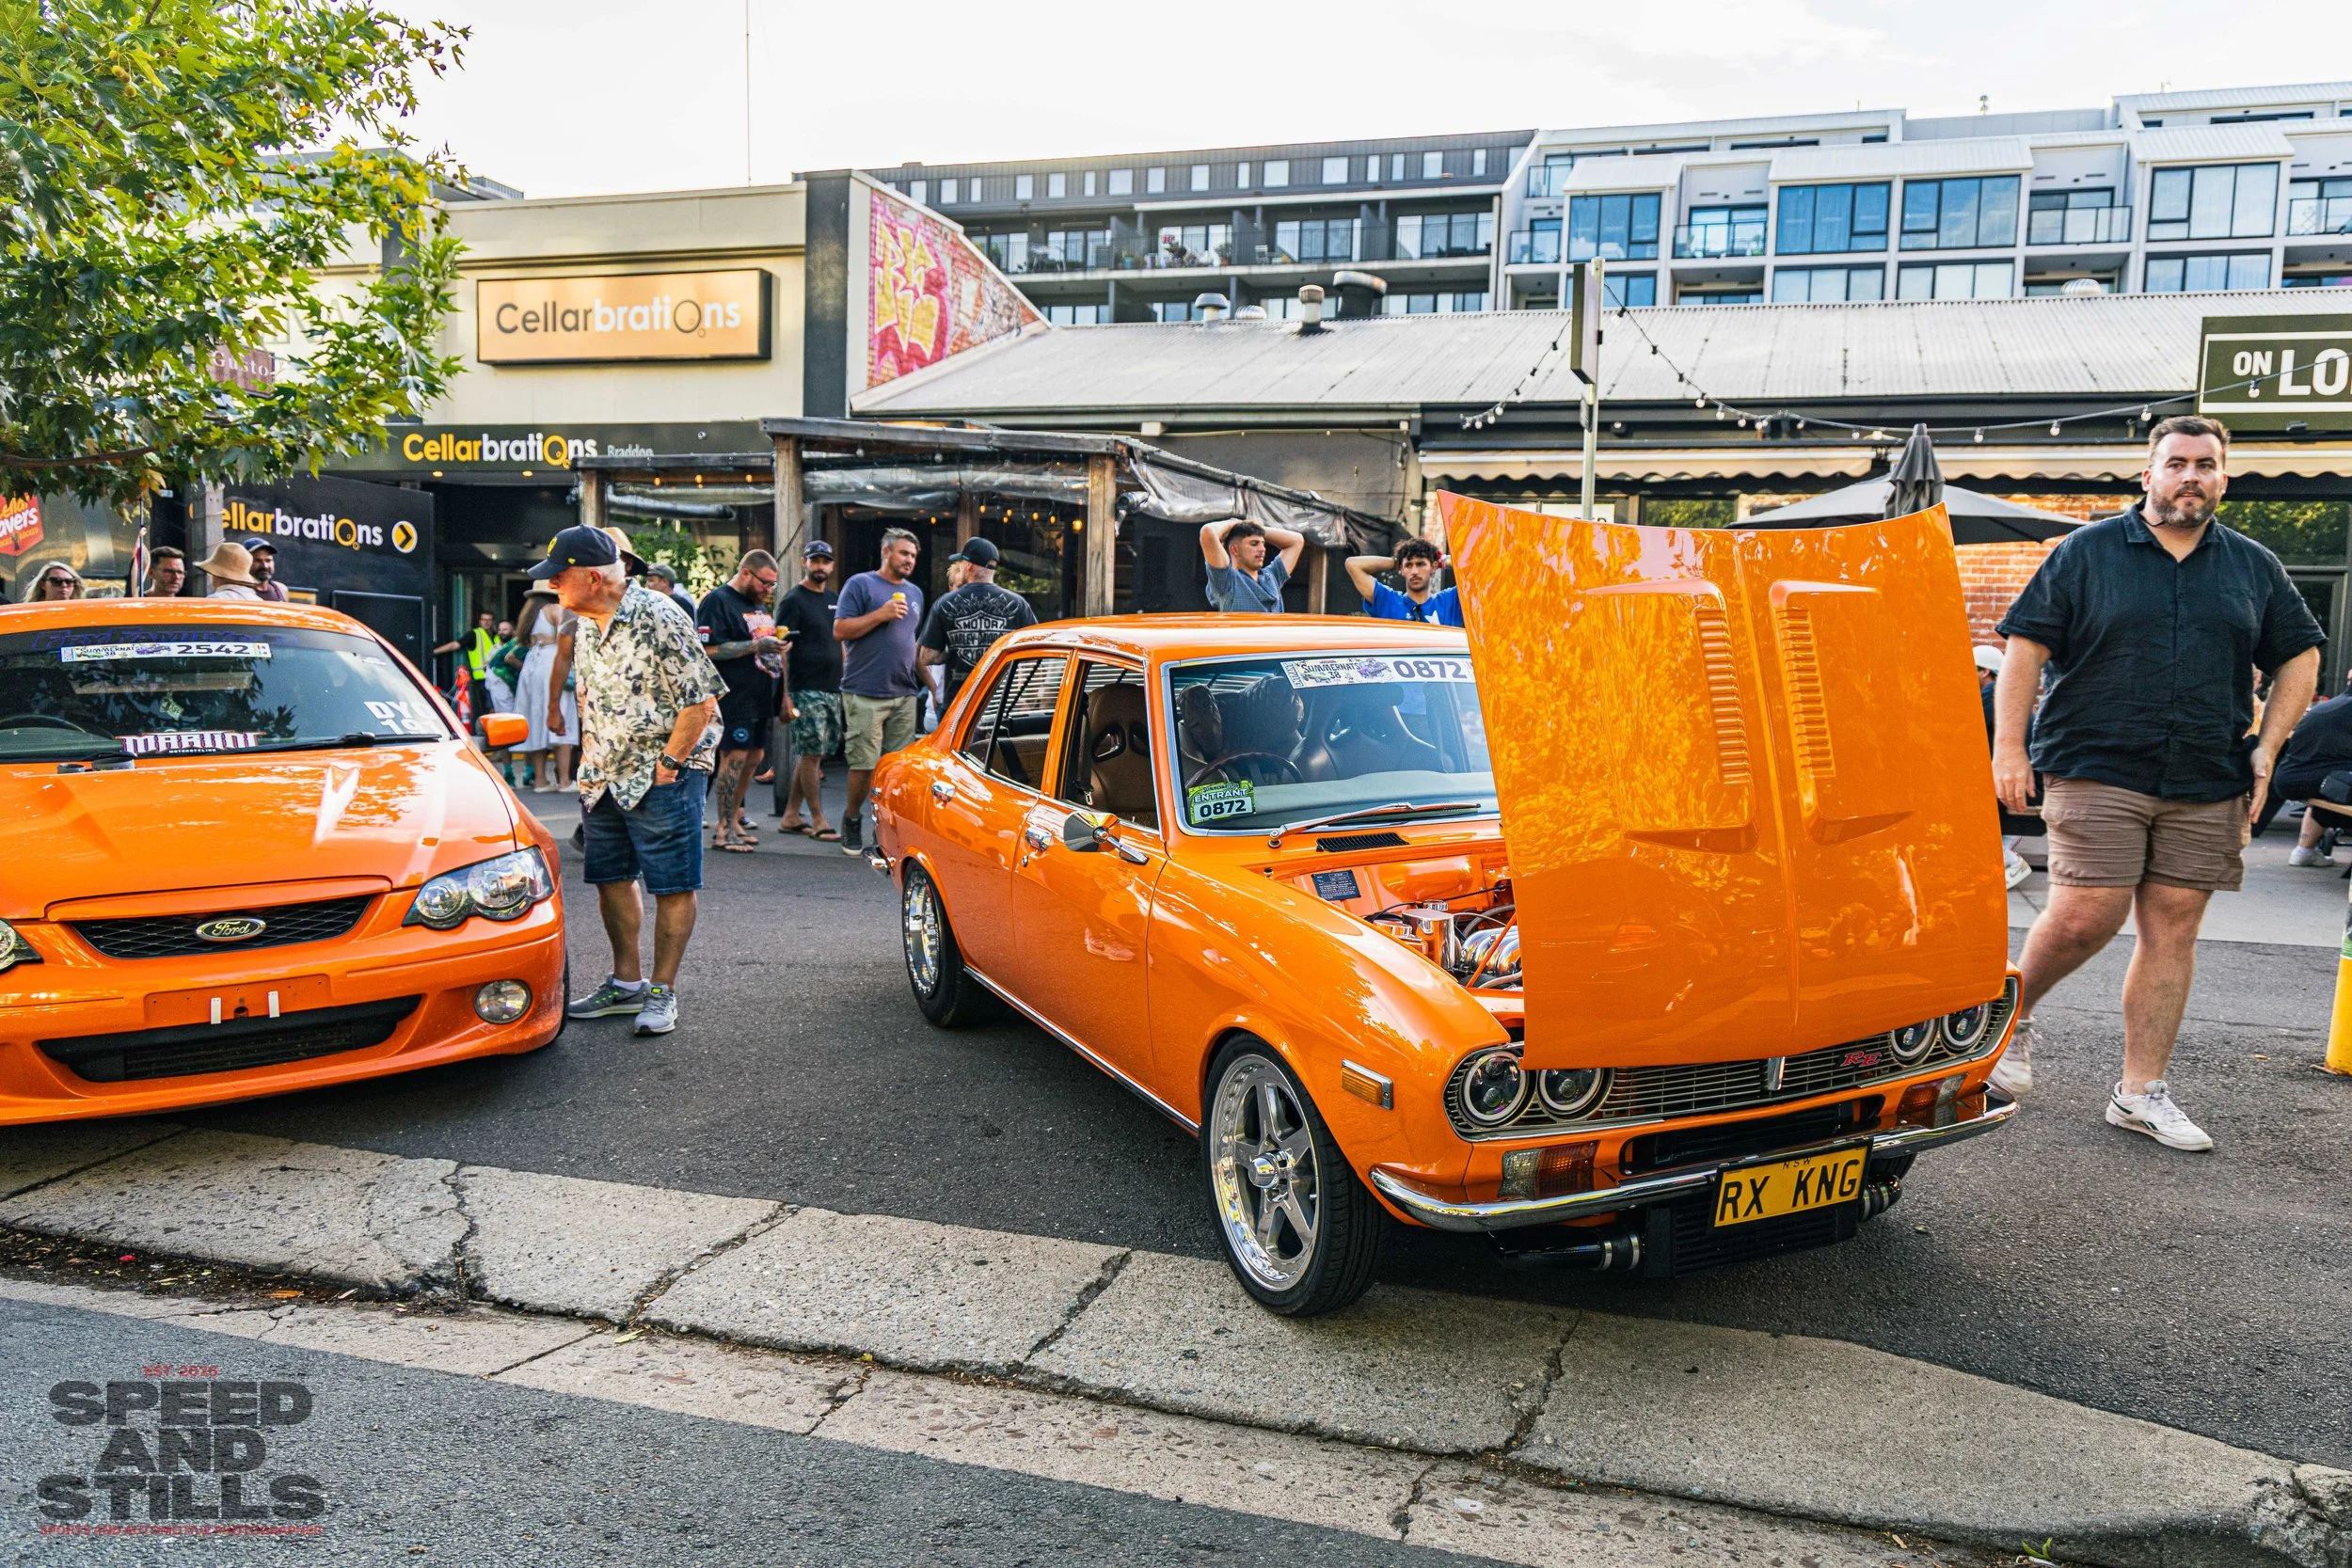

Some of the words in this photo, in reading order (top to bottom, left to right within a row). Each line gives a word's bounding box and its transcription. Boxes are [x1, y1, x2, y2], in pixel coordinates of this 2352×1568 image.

[2233, 350, 2274, 376] ON
[2278, 347, 2352, 396] LO
[607, 443, 655, 457] Braddon
[963, 616, 999, 629] MOTOR
[950, 632, 999, 645] HARLEY-DAVID
[176, 644, 251, 655] 2542
[1301, 661, 1360, 673] SUMMERNATS
[1392, 659, 1468, 679] 0872
[1329, 671, 1342, 679] 38
[1194, 788, 1248, 803] ENTRANT
[1200, 800, 1247, 817] 0872
[212, 921, 250, 937] Ford
[1839, 1051, 1883, 1068] RE
[1783, 1156, 1812, 1169] NSW
[1719, 1175, 1771, 1222] RX
[1791, 1159, 1861, 1208] KNG
